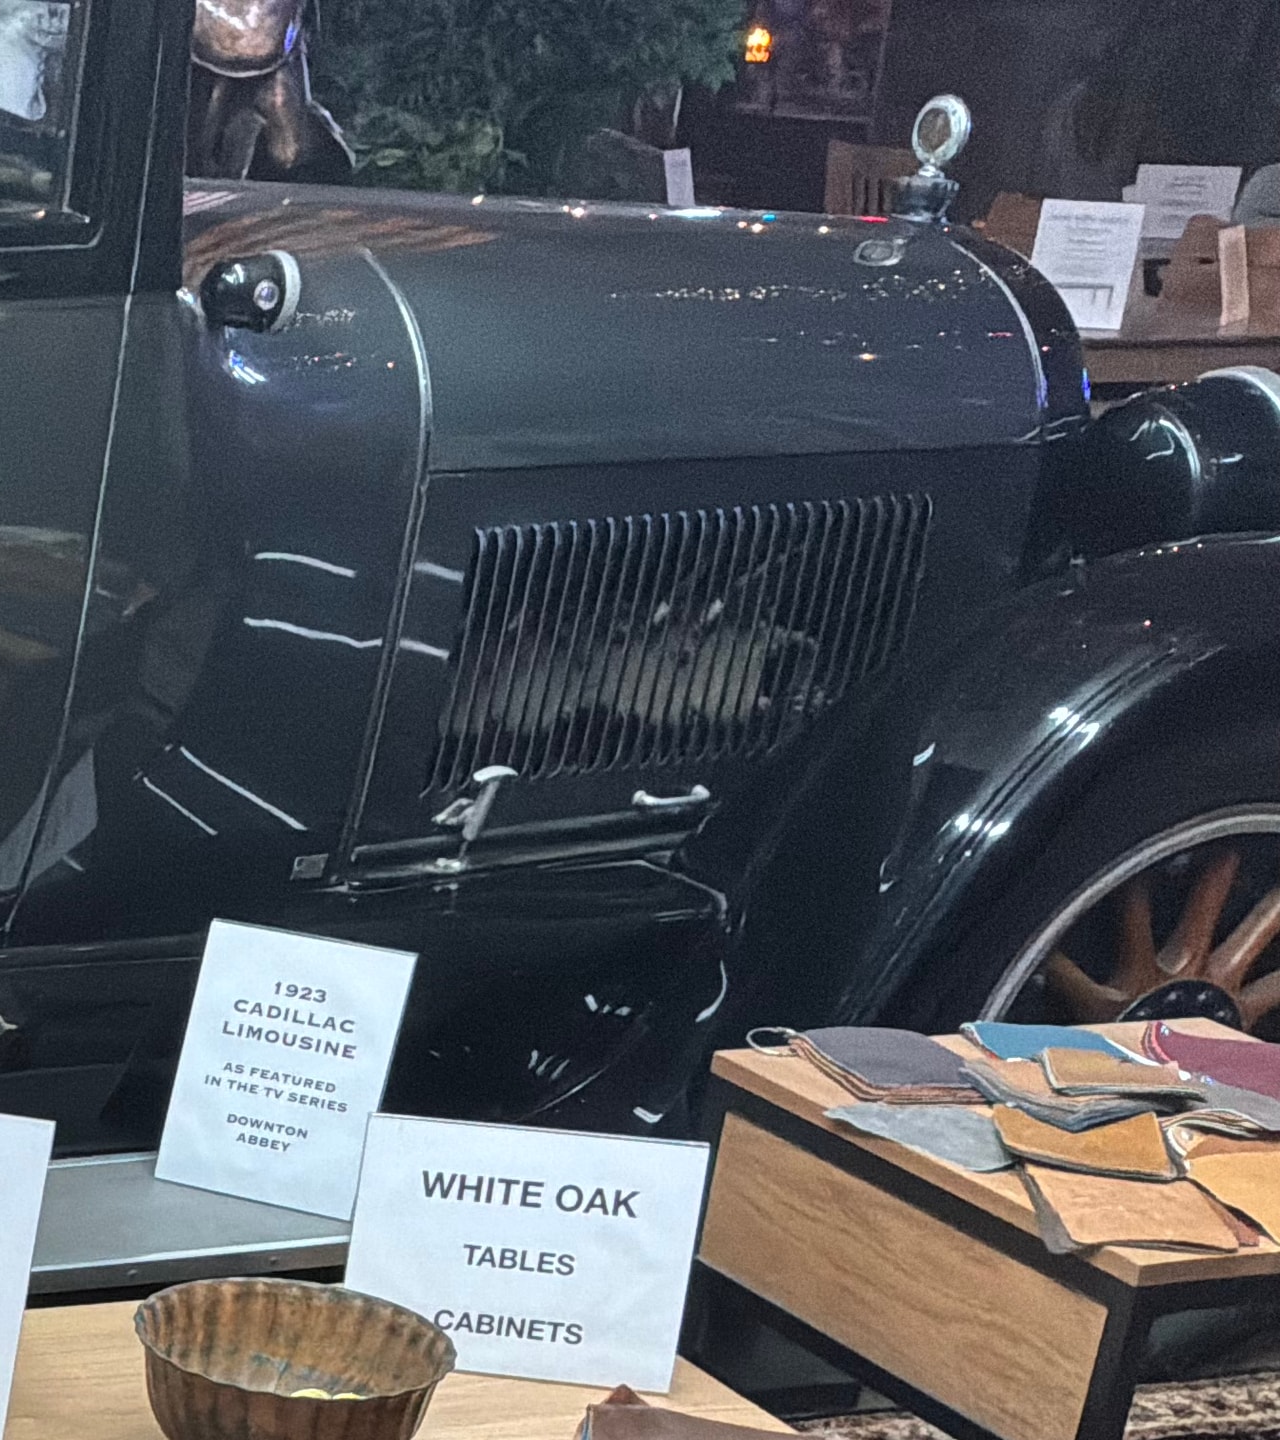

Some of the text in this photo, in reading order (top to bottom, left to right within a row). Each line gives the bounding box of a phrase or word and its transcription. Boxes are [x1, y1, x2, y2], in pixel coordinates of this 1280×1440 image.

[274, 981, 327, 1003] 1923
[233, 999, 356, 1033] CADILLAC
[222, 1021, 357, 1060] LIMOUSINE
[204, 1075, 348, 1113] IN THE TV SERIES
[223, 1062, 336, 1093] AS FEATURED
[227, 1114, 308, 1138] DOWNTON
[236, 1133, 291, 1152] ABBEY
[422, 1170, 640, 1218] WHITE OAK
[463, 1244, 576, 1276] TABLES
[433, 1309, 584, 1345] CABINETS
